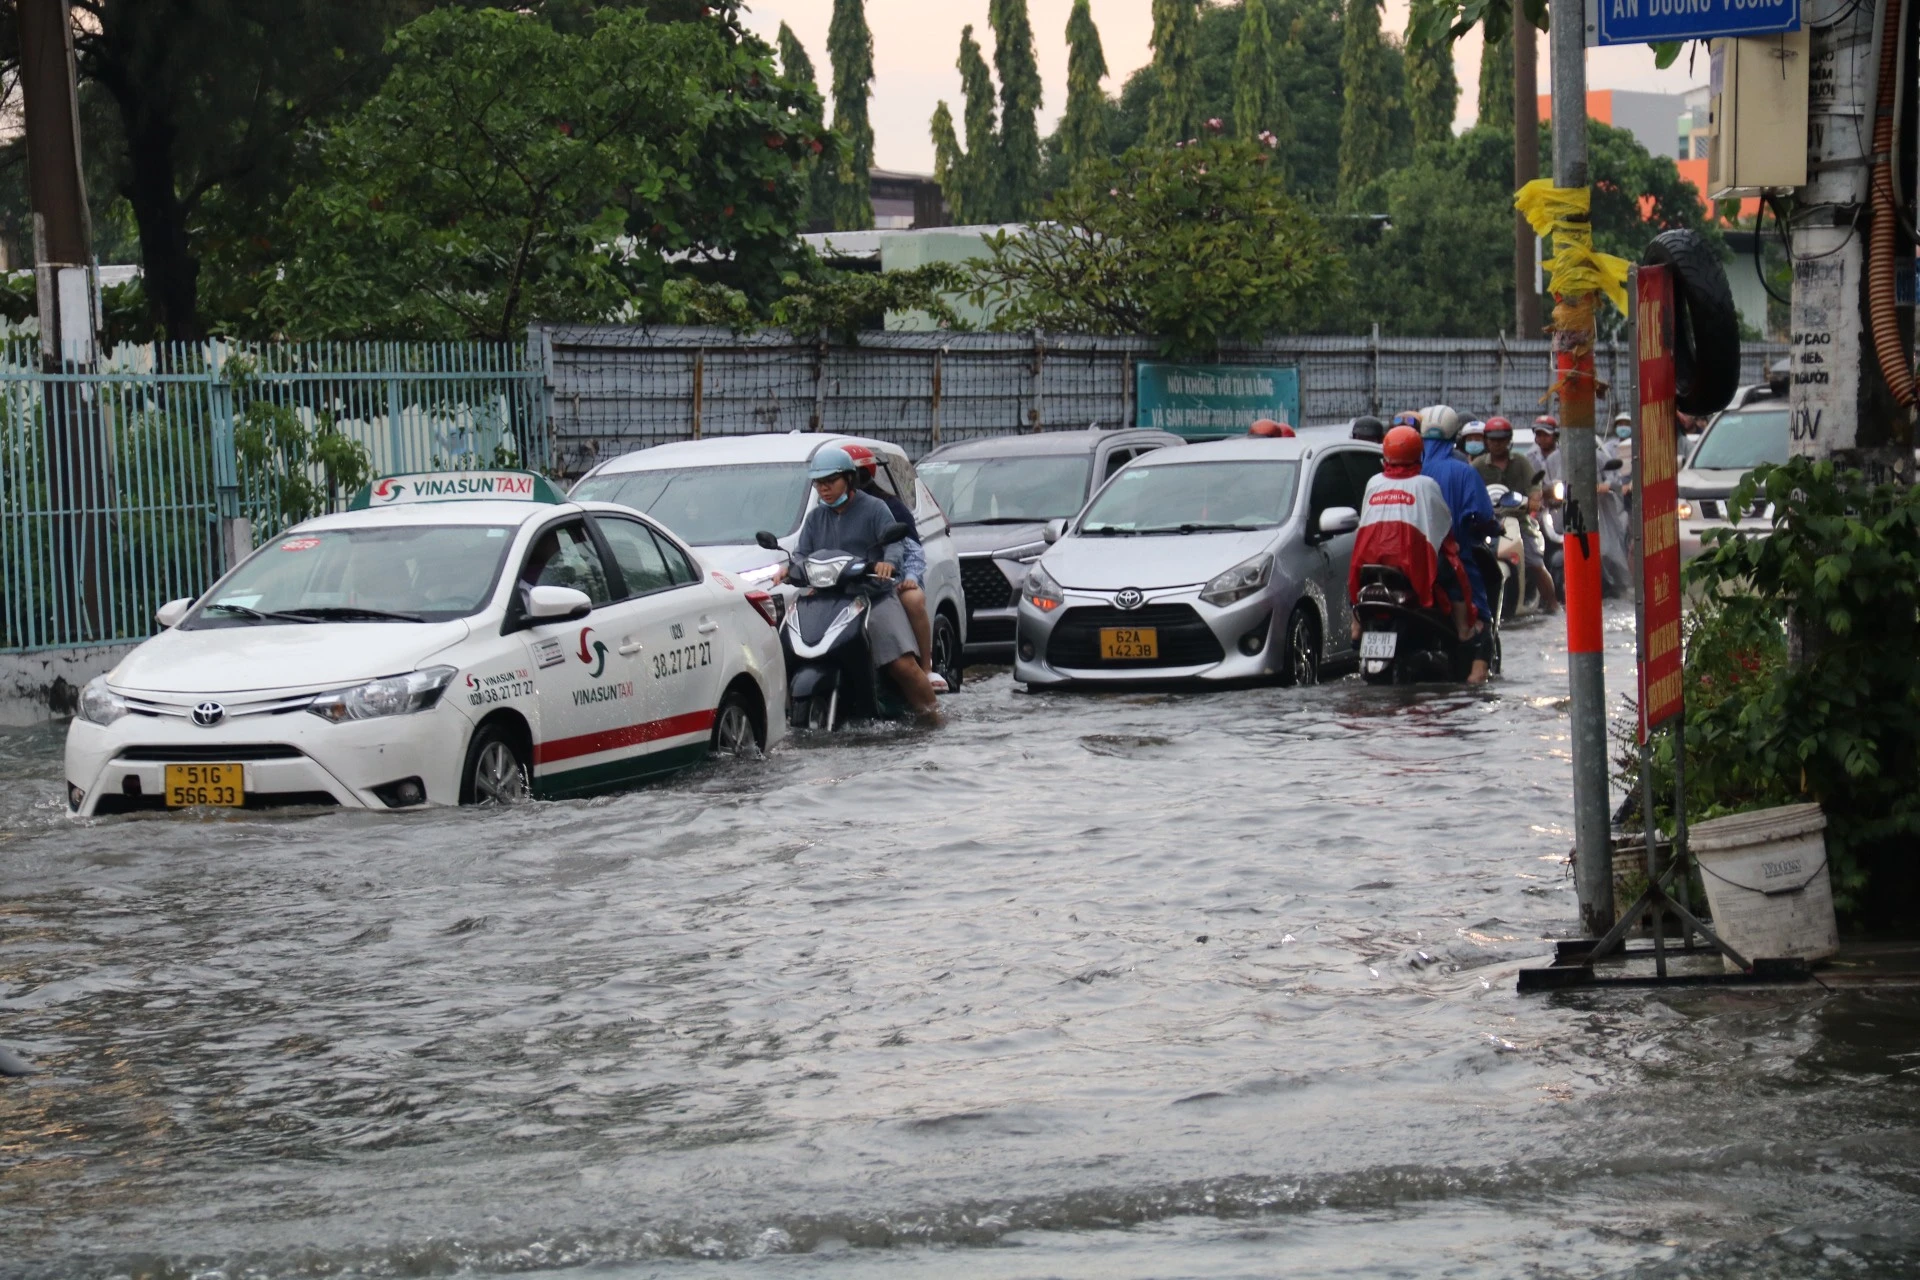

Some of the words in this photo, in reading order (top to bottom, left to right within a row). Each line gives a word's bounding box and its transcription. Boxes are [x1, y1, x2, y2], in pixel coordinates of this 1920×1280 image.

[1804, 333, 1831, 345] CAO
[1116, 630, 1141, 643] 62A
[653, 649, 682, 679] 38.27
[685, 645, 697, 670] 27
[699, 641, 712, 667] 27
[483, 672, 515, 687] VINASUN
[511, 683, 522, 697] 27
[523, 681, 533, 695] 27
[188, 766, 221, 784] 51G
[174, 786, 235, 805] 566.33
